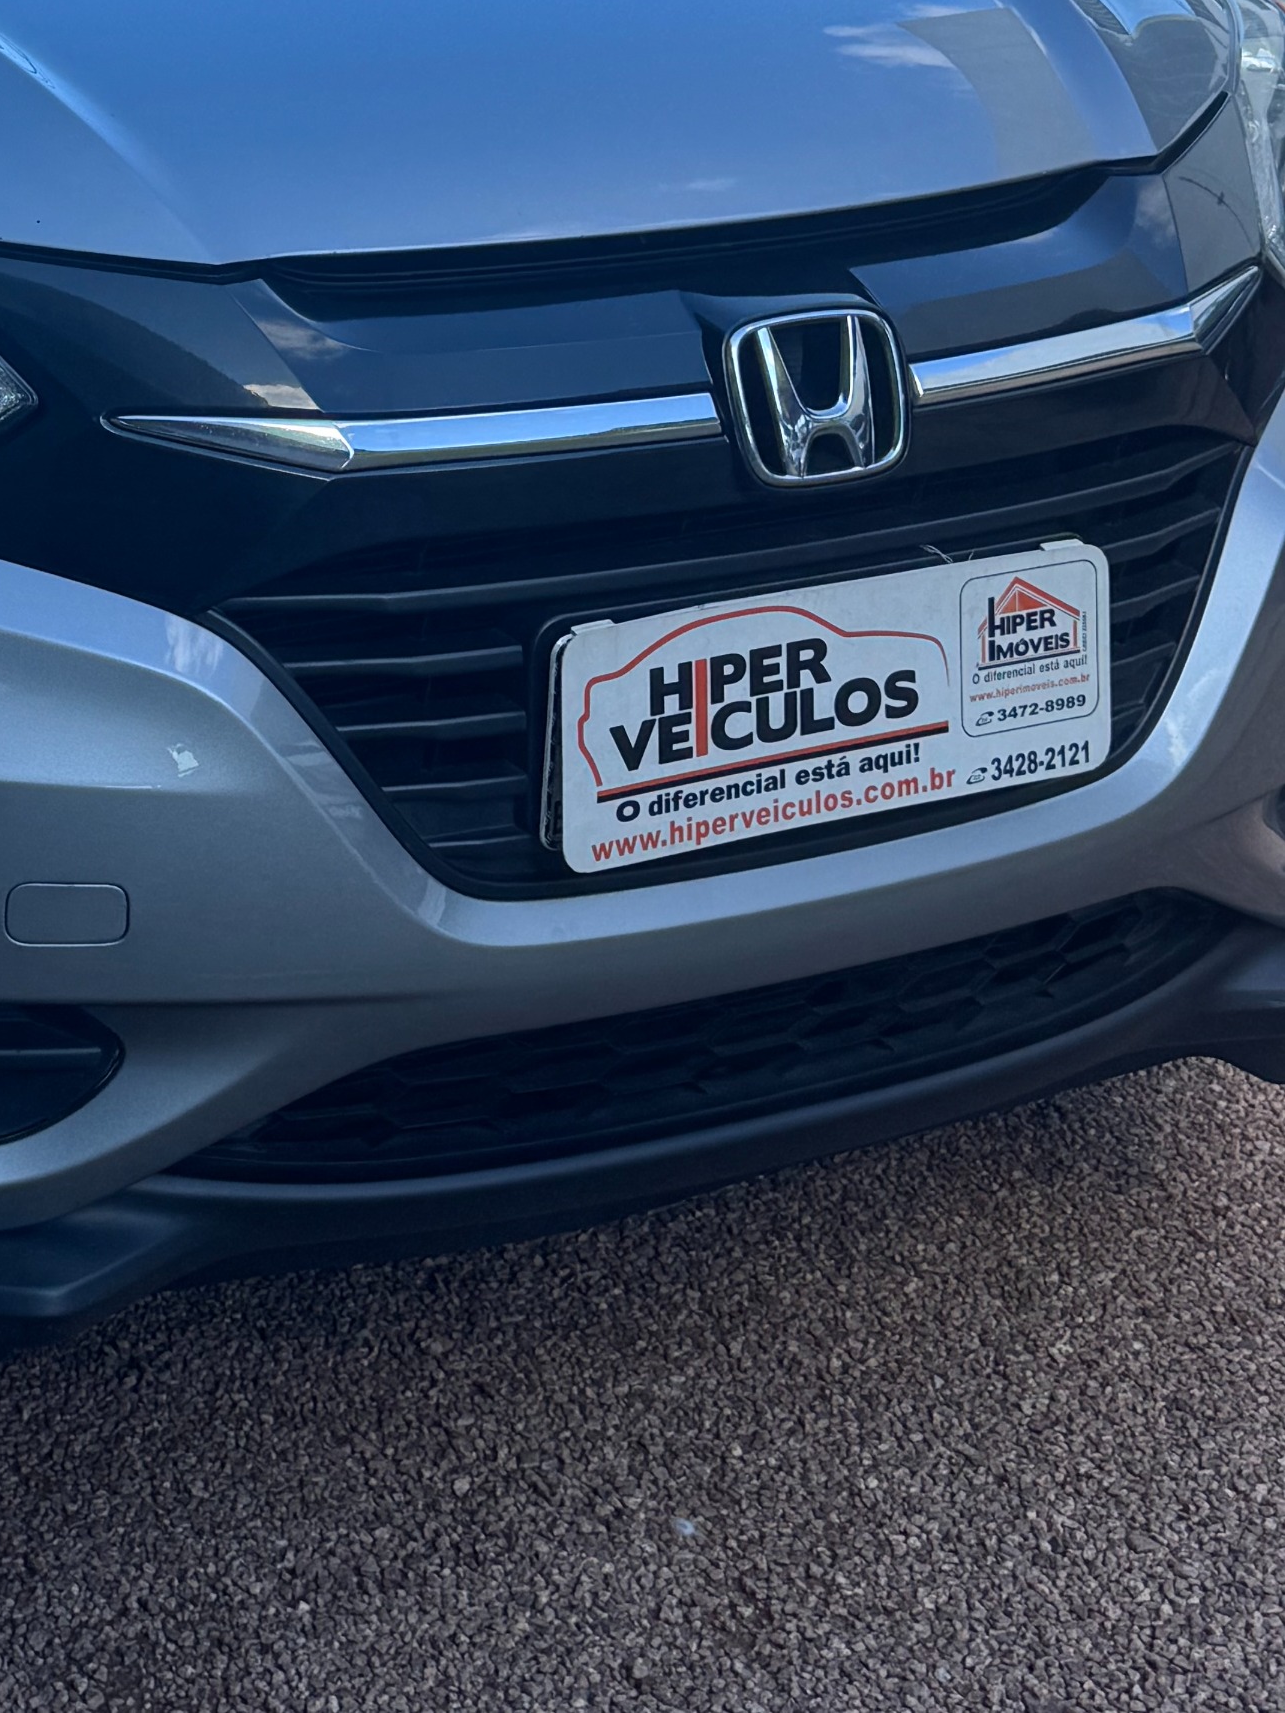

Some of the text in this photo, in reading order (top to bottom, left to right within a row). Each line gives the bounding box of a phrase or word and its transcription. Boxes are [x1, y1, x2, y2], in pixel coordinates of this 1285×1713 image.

[988, 597, 1056, 638] HIPER
[988, 632, 1070, 661] IMÓVEIS
[649, 638, 832, 716] HIPER
[969, 672, 1090, 703] www.hiperimoveis.com.br
[972, 654, 1087, 685] O diferencial está aqui!
[609, 670, 919, 772] VEICULOS
[997, 694, 1086, 722] 3472-8989
[991, 739, 1090, 781] 3428-2121
[616, 742, 920, 823] O diferencial está aqui!
[591, 767, 956, 863] www.hiperveiculos.com.br
